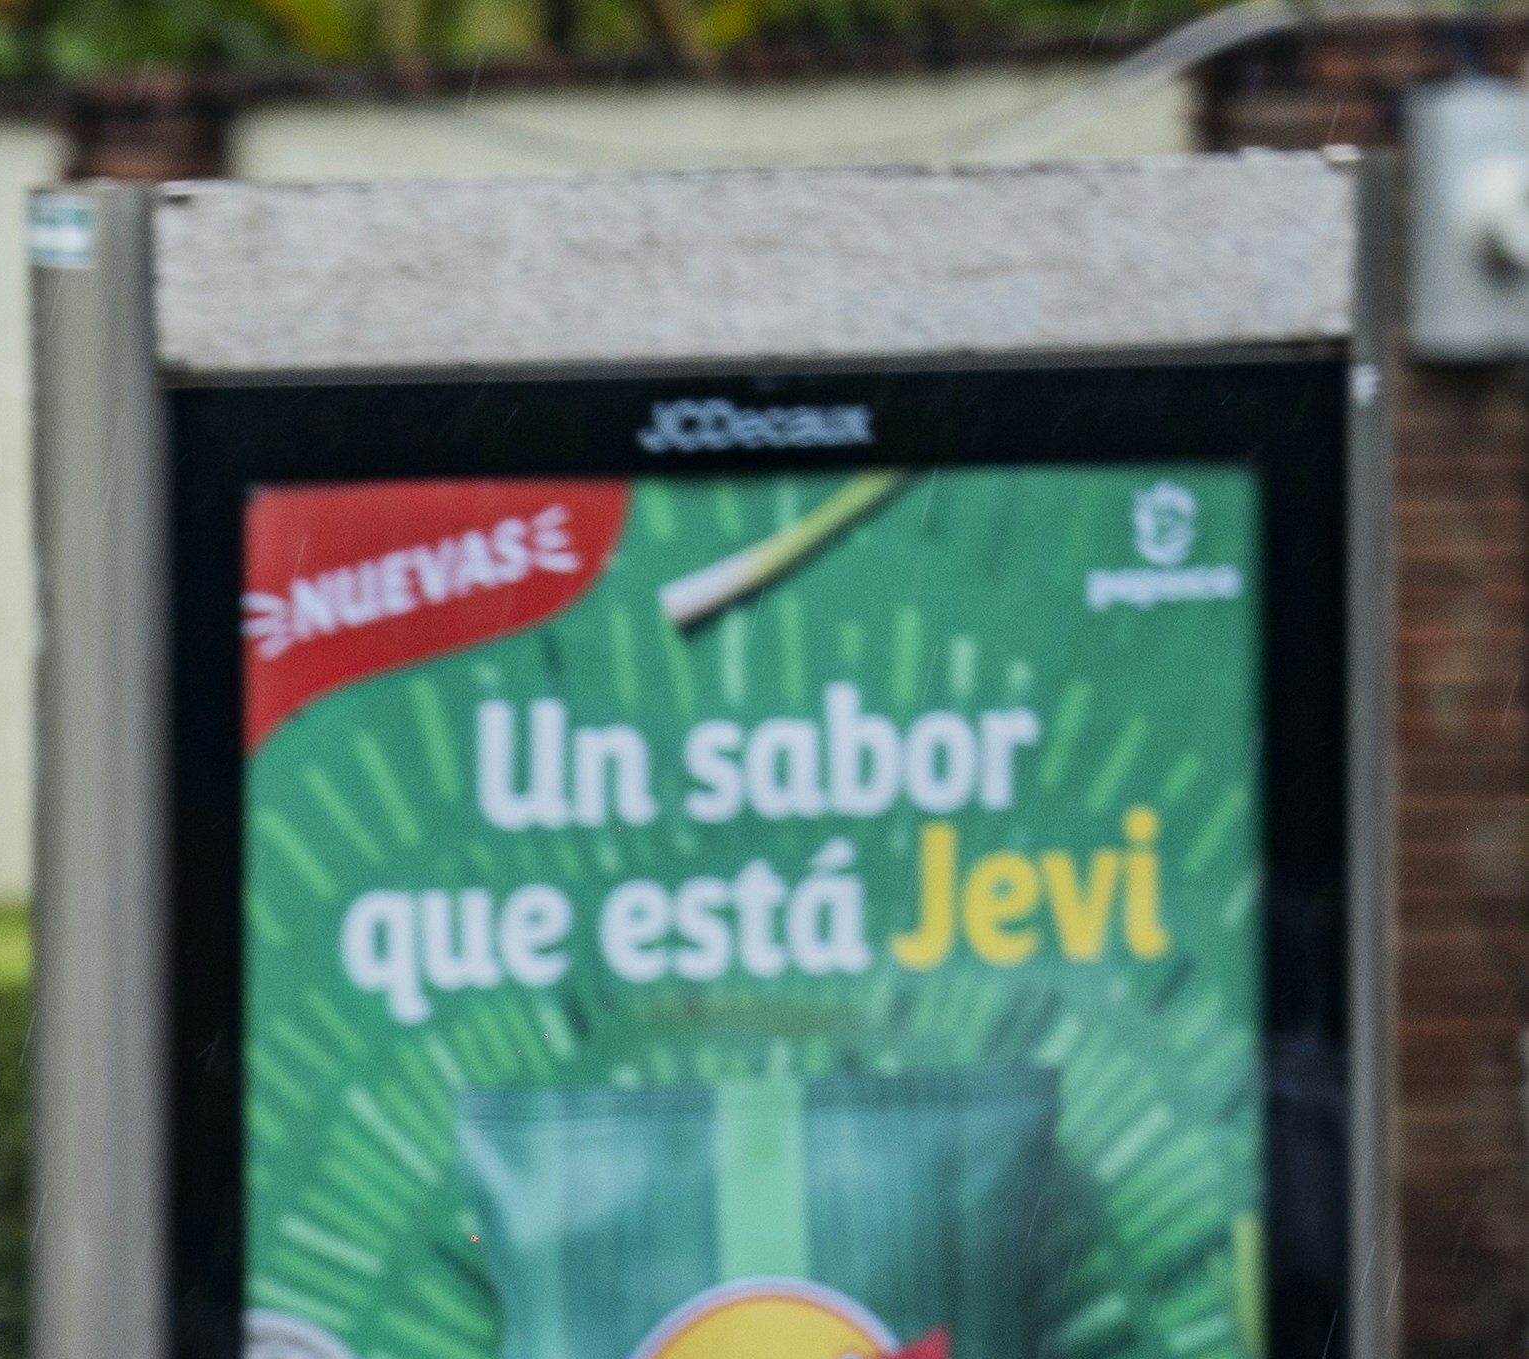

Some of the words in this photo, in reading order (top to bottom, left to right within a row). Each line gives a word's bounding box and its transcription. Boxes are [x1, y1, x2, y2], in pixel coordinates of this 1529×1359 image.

[637, 398, 874, 452] JCDecaux
[291, 517, 531, 642] NUEVAS
[473, 696, 661, 832] Un
[683, 680, 1041, 825] sabor
[339, 880, 575, 1026] que
[599, 836, 873, 984] está
[888, 804, 1171, 972] Jevi
